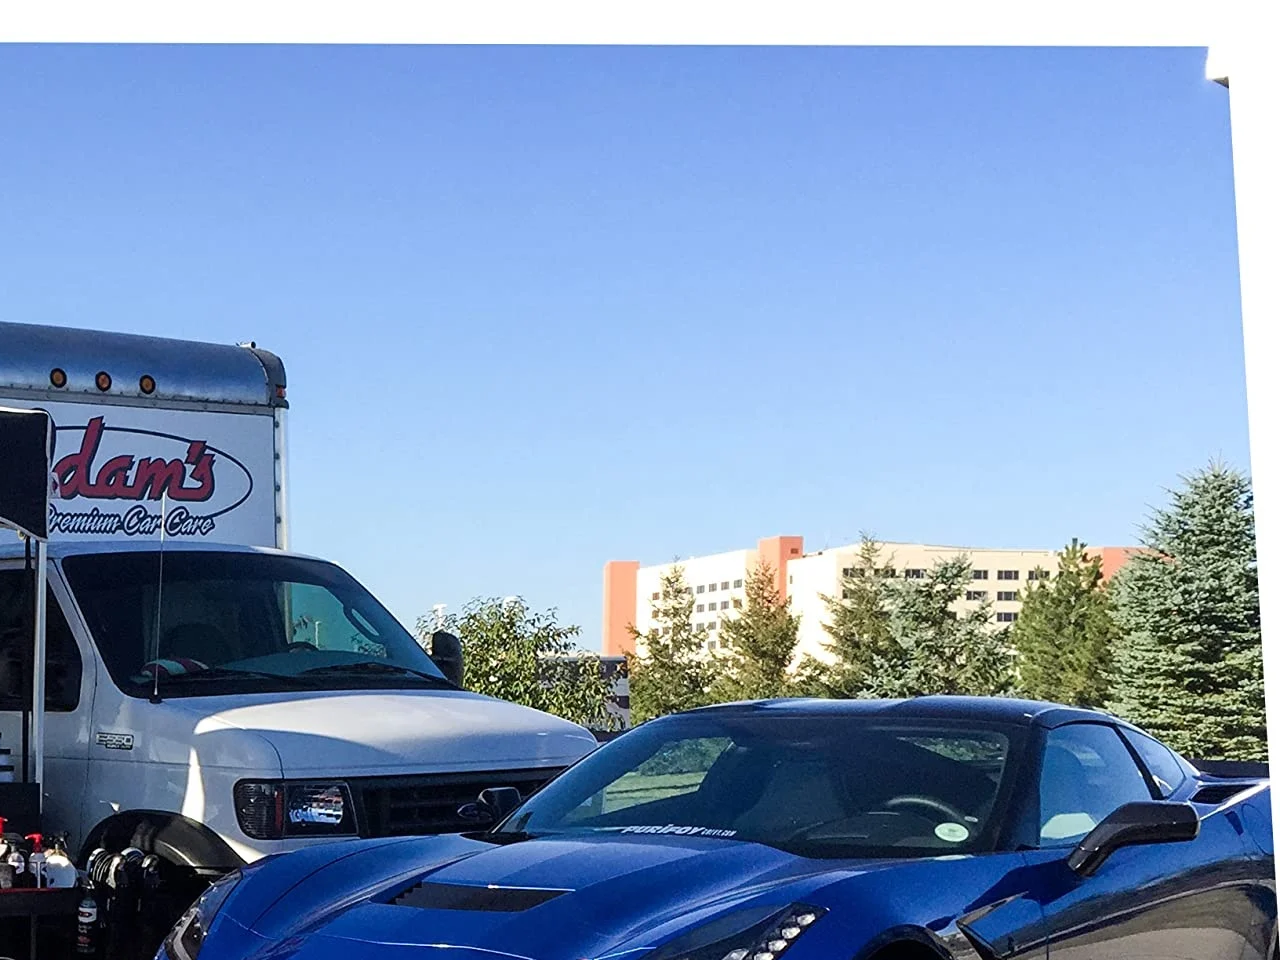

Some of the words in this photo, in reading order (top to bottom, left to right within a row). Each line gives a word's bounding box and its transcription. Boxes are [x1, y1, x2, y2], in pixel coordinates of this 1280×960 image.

[52, 416, 216, 501] dam's
[121, 505, 162, 536] Car
[164, 506, 216, 536] Care
